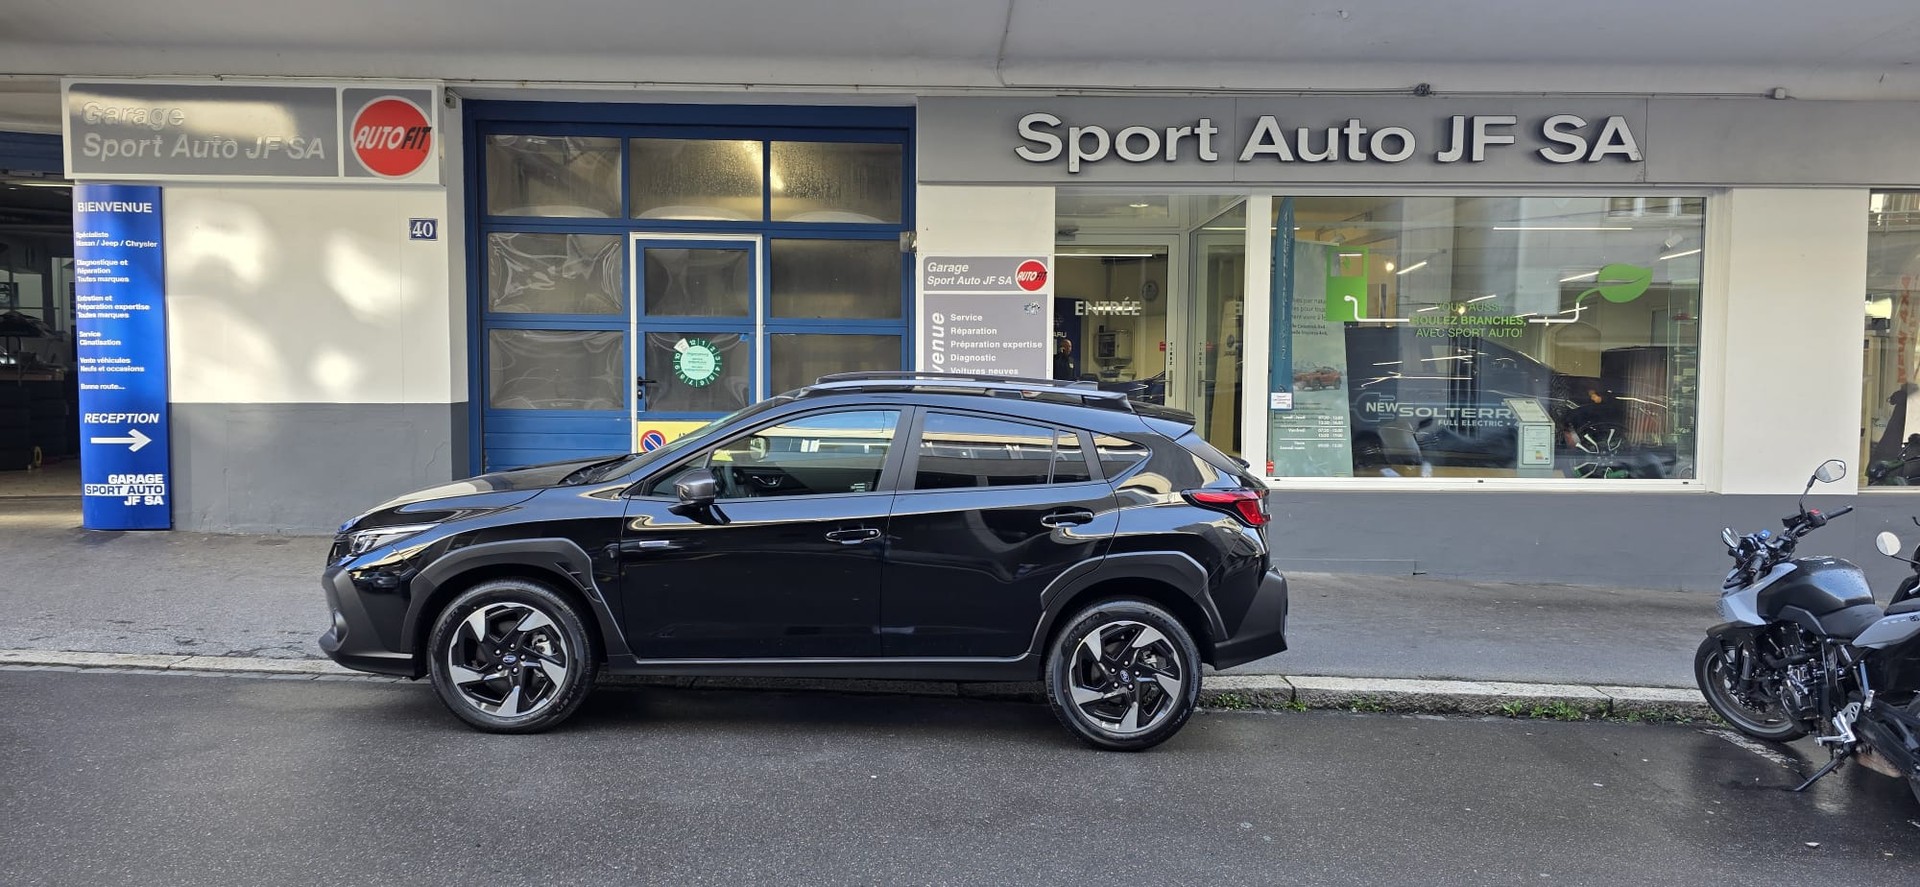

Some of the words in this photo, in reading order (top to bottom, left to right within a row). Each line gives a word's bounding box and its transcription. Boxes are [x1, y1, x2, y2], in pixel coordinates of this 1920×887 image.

[82, 101, 185, 130] Garage
[354, 125, 433, 150] AUTOFIT
[82, 132, 163, 161] Sport
[171, 134, 238, 159] Auto
[245, 137, 285, 159] JF
[286, 136, 326, 160] SA
[1014, 112, 1218, 174] Sport
[1238, 115, 1416, 163] Auto
[1436, 114, 1517, 163] JF
[1538, 113, 1644, 163] SA
[77, 201, 153, 213] BIENVENUE
[411, 221, 434, 238] 40
[101, 240, 119, 248] Jeep
[125, 240, 158, 249] Chrysler
[927, 262, 969, 275] Garage
[927, 276, 955, 286] Sport
[956, 276, 981, 285] Auto
[983, 276, 996, 285] JF
[998, 276, 1012, 285] SA
[1074, 297, 1141, 316] ENTRÉE
[950, 314, 983, 322] Service
[950, 327, 997, 336] Réparation
[1416, 328, 1445, 338] AVEC
[1448, 328, 1485, 338] SPORT
[1488, 328, 1523, 338] AUTO!
[932, 312, 945, 373] venue
[950, 341, 1000, 349] Préparation
[1003, 341, 1043, 349] expertise
[950, 354, 997, 362] Diagnostic
[1366, 402, 1397, 413] NEW
[1399, 407, 1514, 419] SOLTERR
[84, 413, 160, 424] RECEPTION
[1438, 419, 1459, 427] FULL
[1461, 420, 1504, 428] ELECTRIC
[108, 474, 164, 484] GARAGE
[86, 485, 123, 495] SPORT
[126, 485, 163, 495] AUTO
[124, 496, 141, 506] JF
[144, 496, 164, 506] SA
